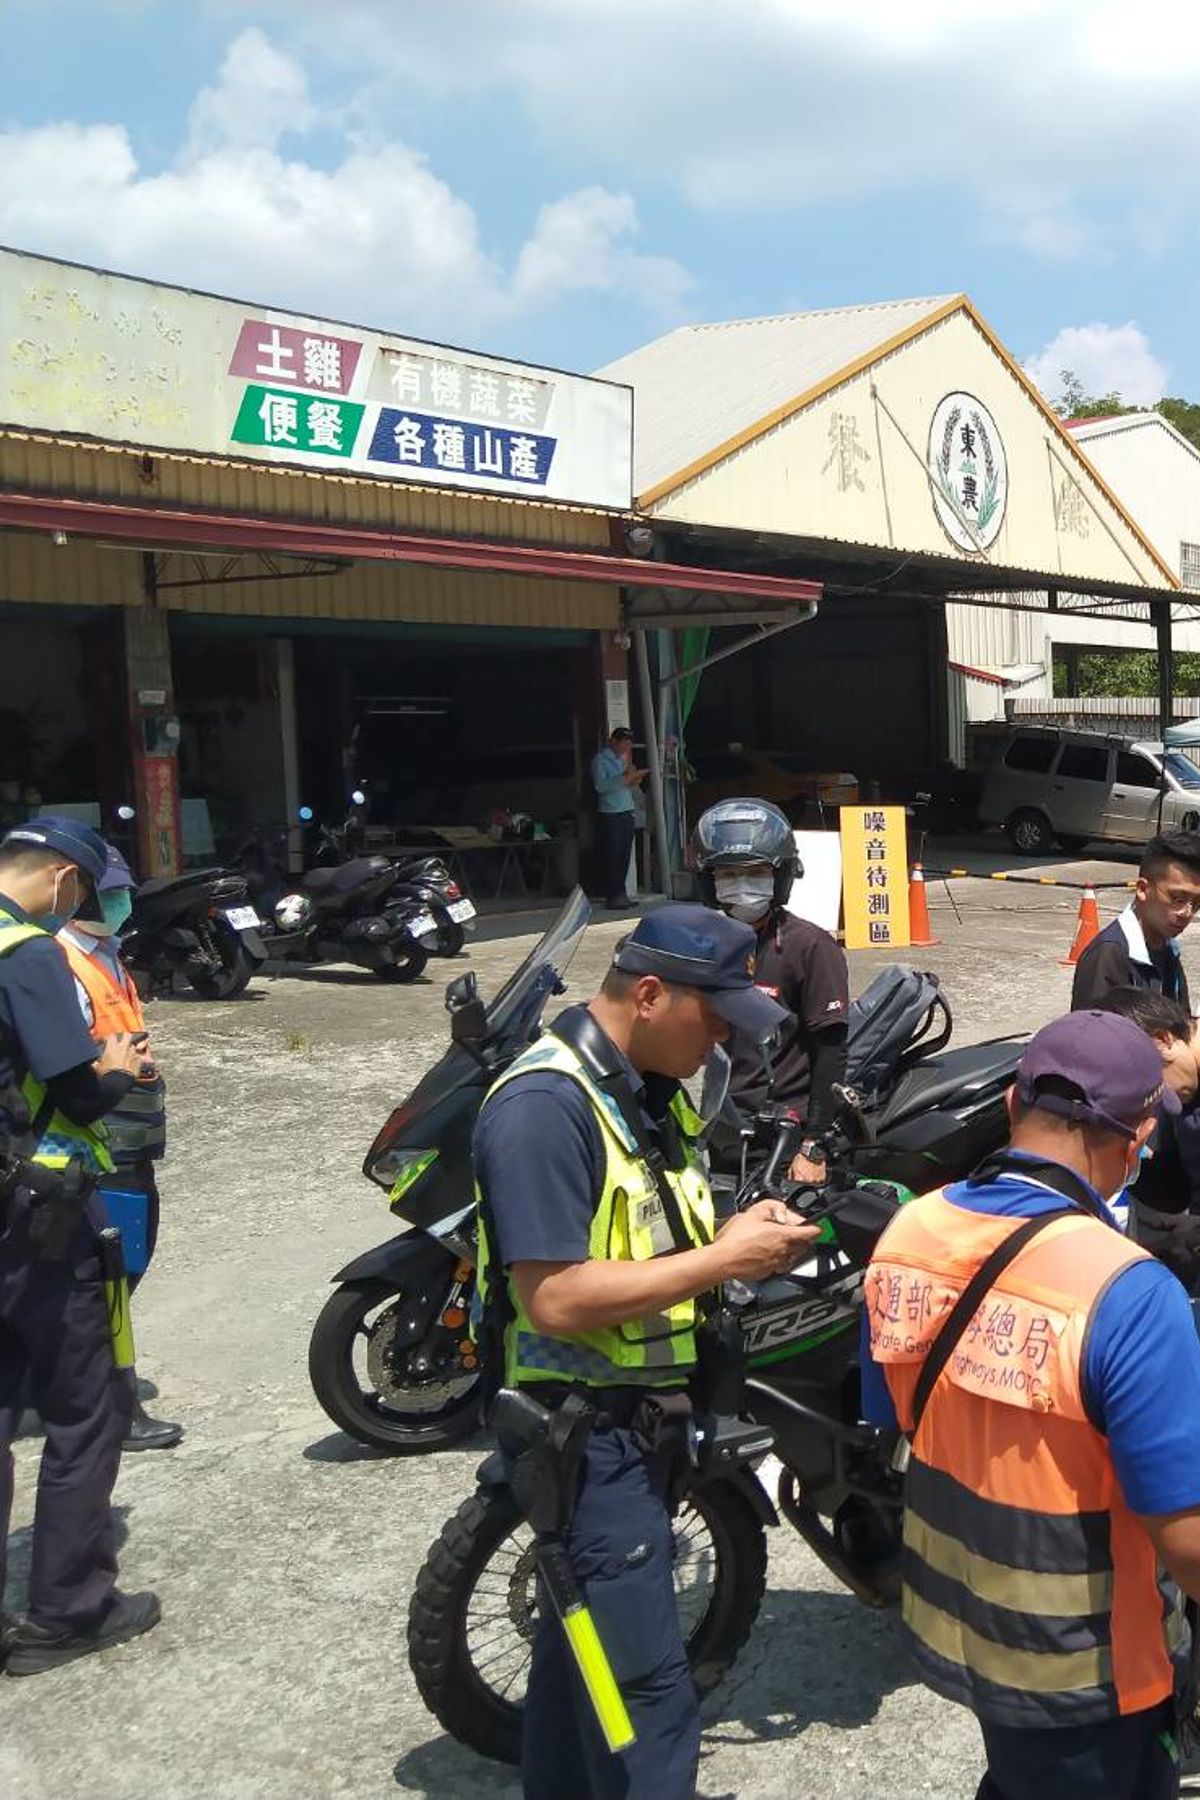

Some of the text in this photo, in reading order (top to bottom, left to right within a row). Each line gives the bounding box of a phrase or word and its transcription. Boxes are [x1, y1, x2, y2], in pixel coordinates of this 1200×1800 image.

[256, 328, 341, 390] 土雞
[257, 392, 344, 452] 便餐
[393, 416, 540, 480] 各種山產
[863, 811, 891, 944] 噪音待測區
